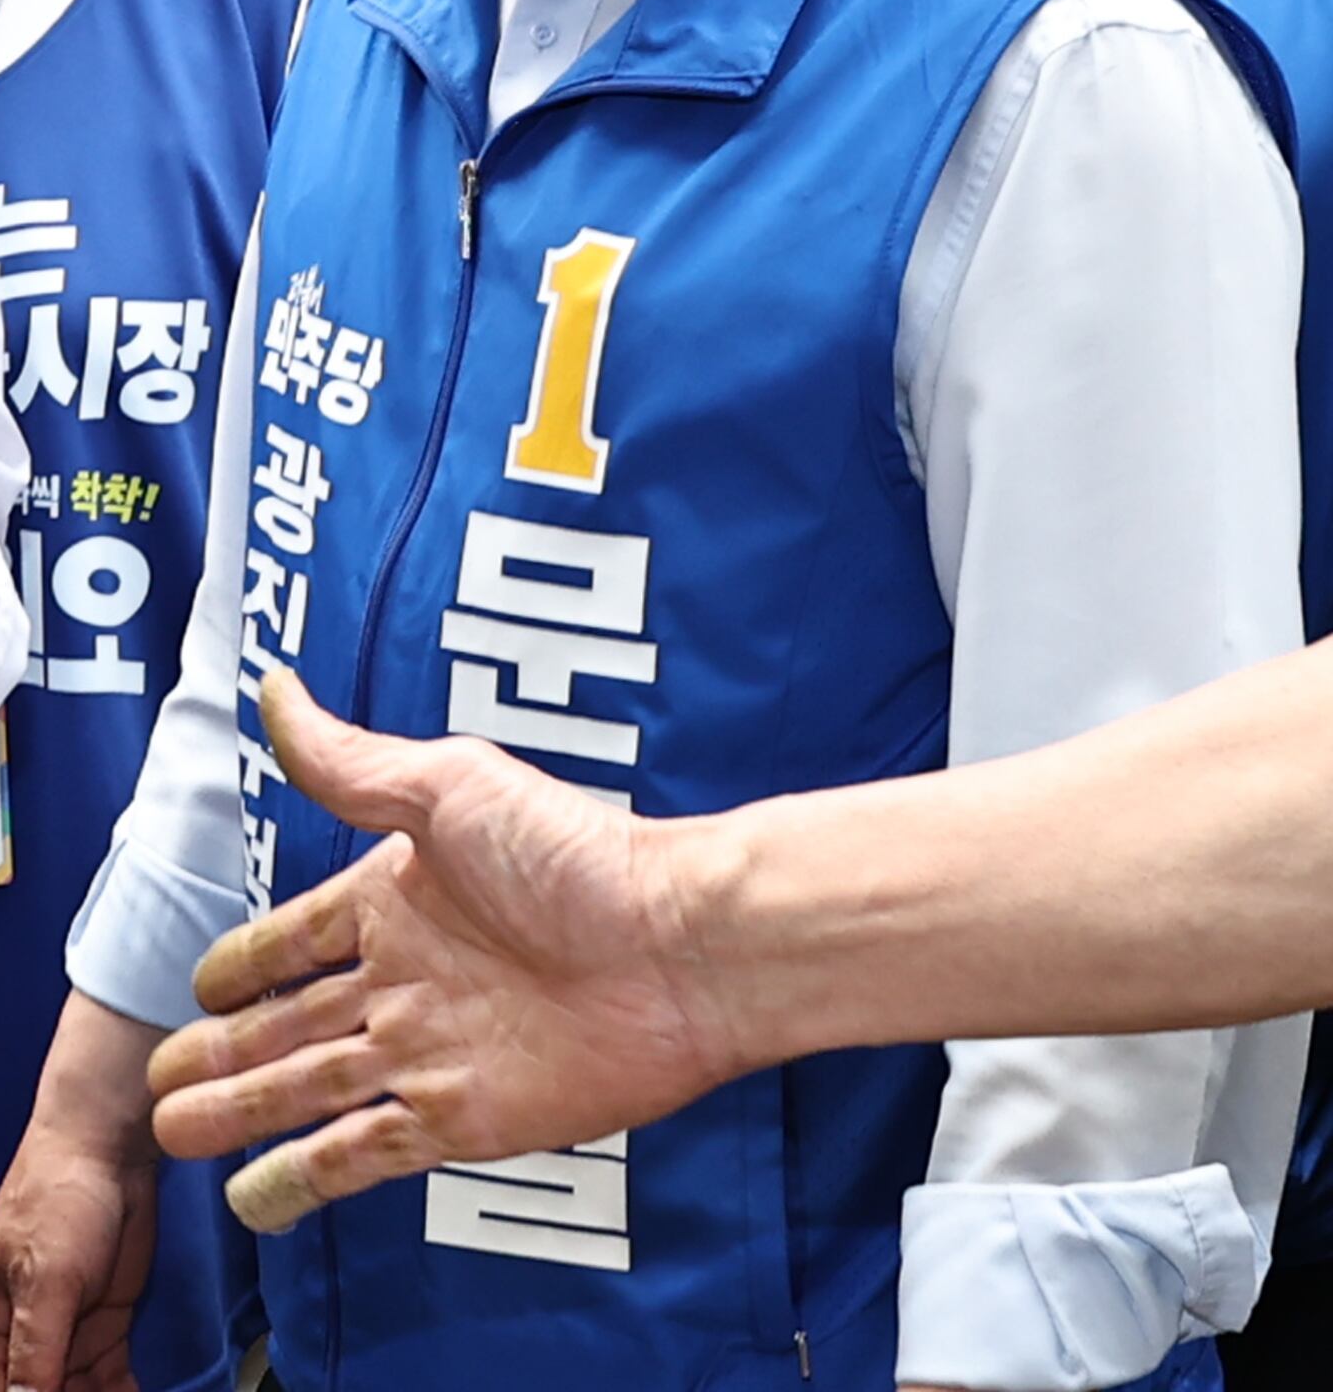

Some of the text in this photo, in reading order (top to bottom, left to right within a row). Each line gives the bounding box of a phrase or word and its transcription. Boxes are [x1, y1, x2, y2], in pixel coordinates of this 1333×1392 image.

[3, 296, 212, 425] 시장
[259, 297, 383, 427] 민주당
[504, 226, 638, 495] 1
[69, 471, 161, 524] 착착!
